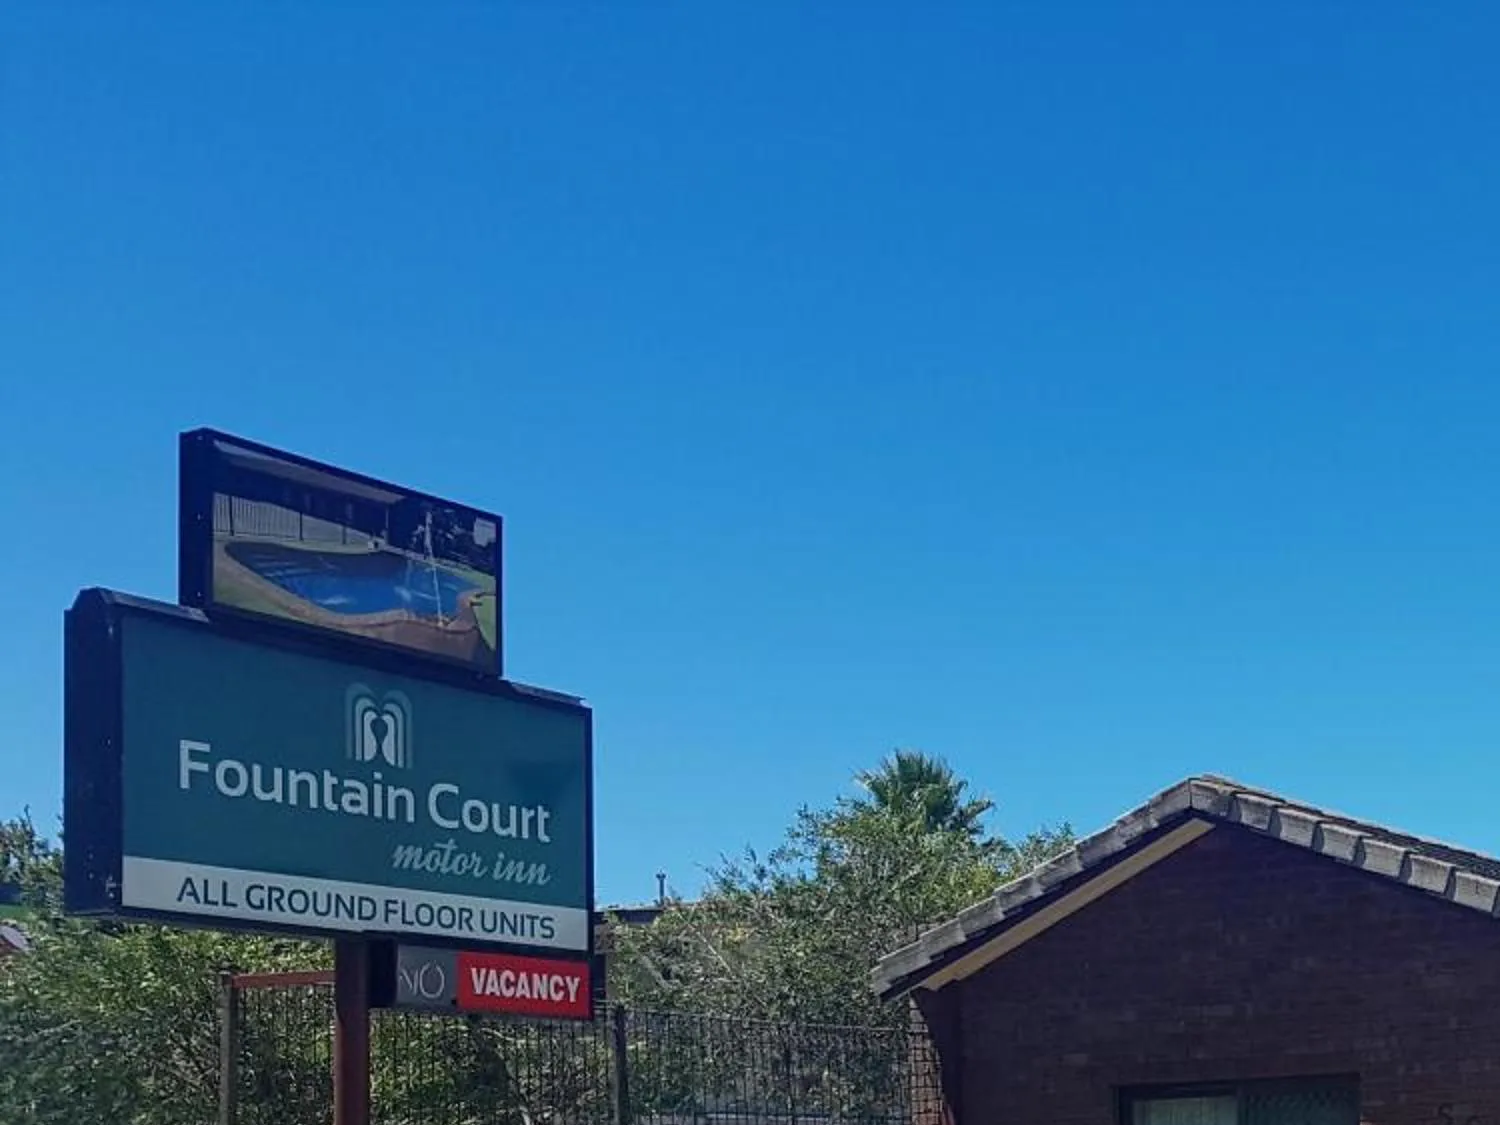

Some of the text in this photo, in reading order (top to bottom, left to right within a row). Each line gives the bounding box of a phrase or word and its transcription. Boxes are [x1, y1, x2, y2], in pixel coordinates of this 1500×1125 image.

[179, 739, 551, 843] Fountain Court
[392, 838, 551, 886] motor inn
[176, 876, 555, 940] ALL GROUND FLOOR UNITS
[400, 960, 580, 1003] NO VACANCY
